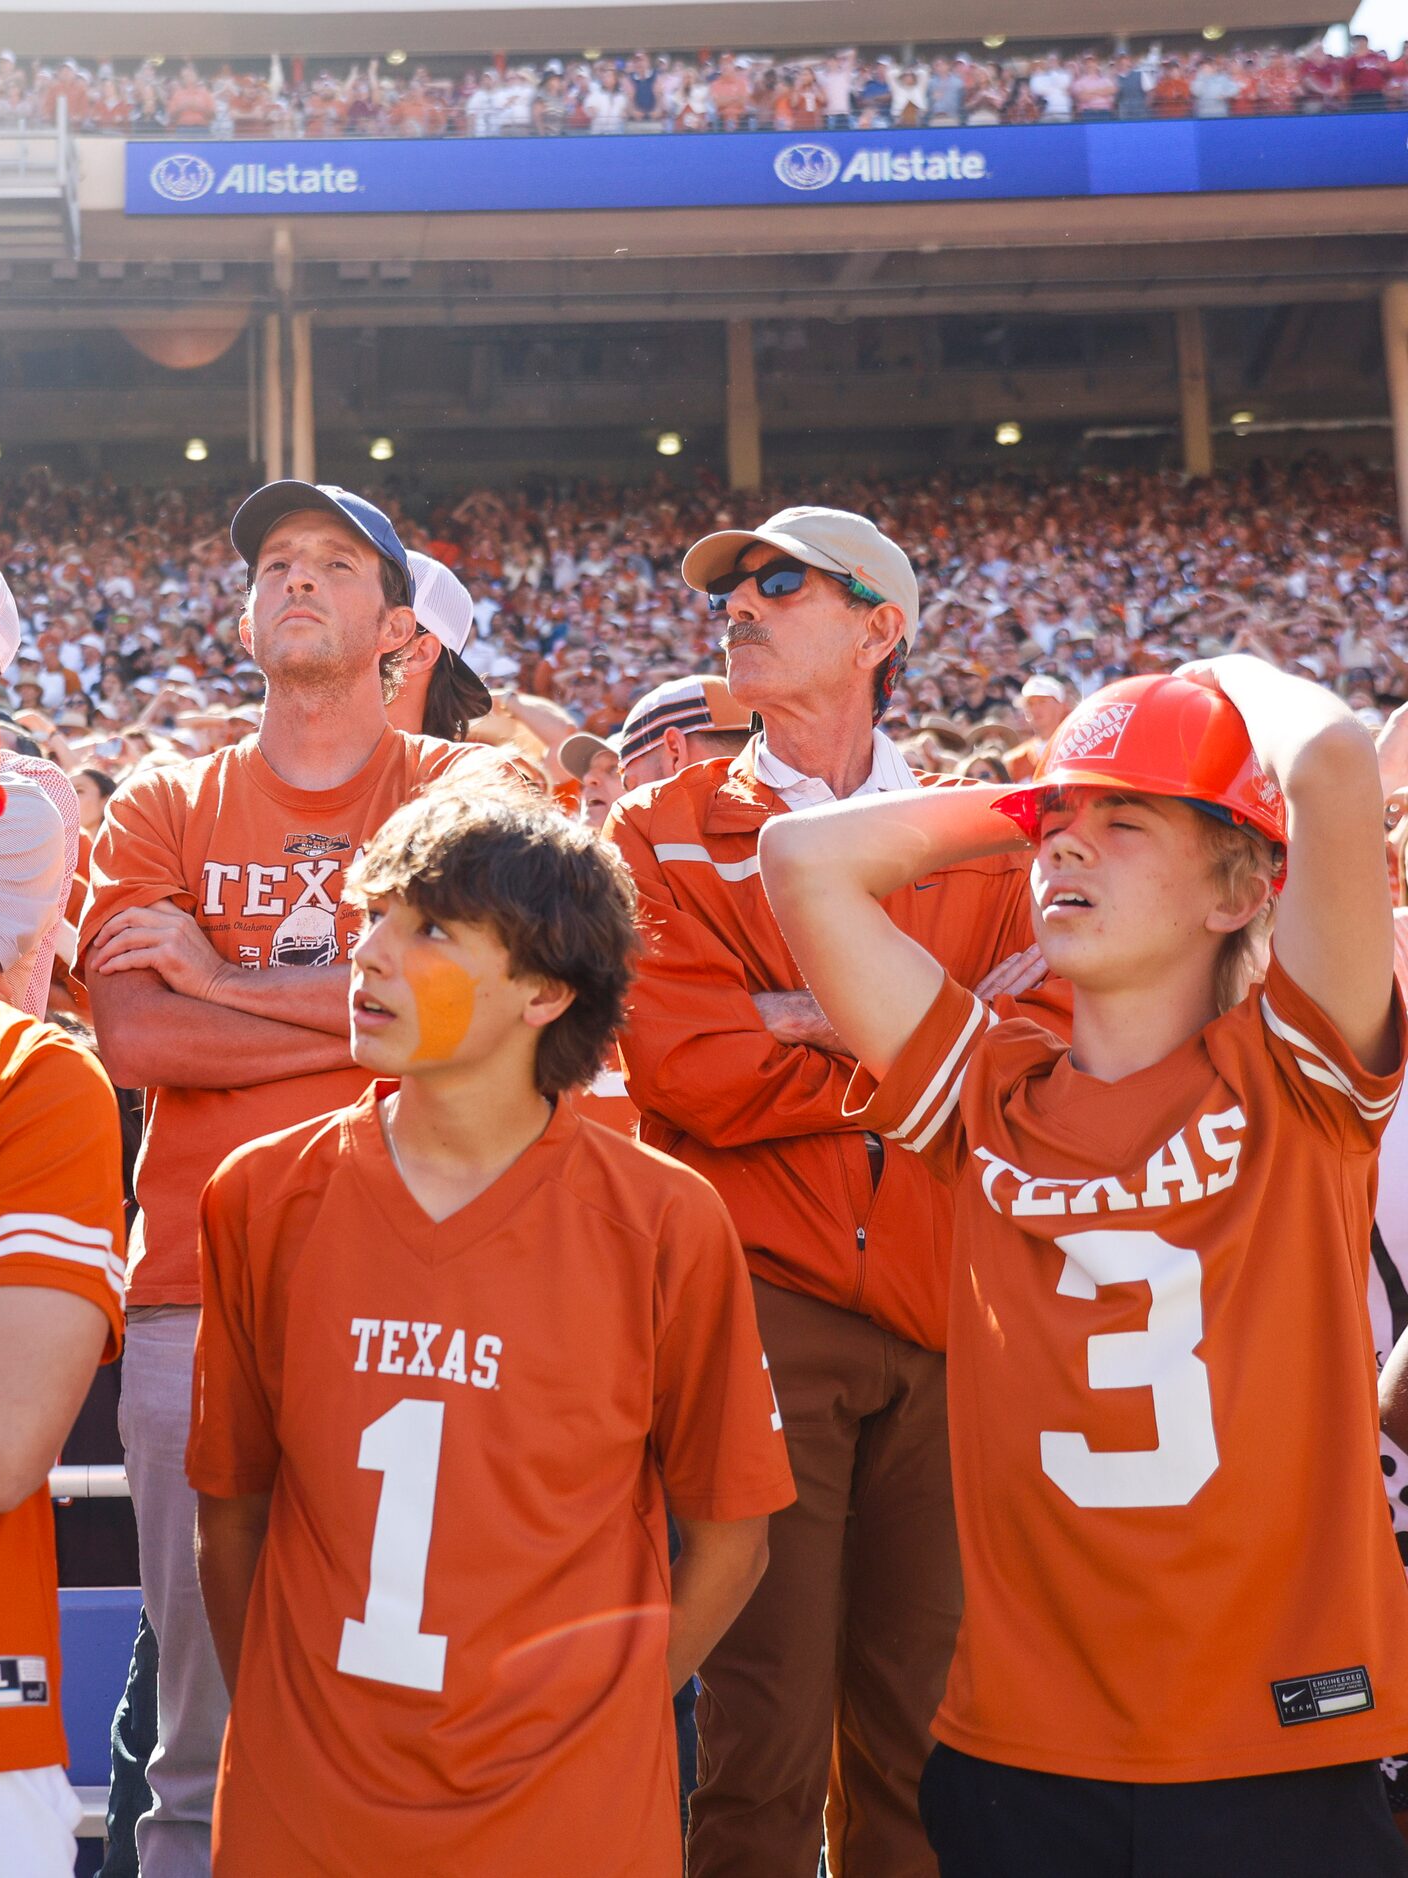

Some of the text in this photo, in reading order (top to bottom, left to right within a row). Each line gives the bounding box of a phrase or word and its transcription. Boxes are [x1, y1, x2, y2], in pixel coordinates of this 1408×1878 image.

[216, 164, 358, 194] Allstate
[841, 147, 986, 182] Allstate
[1058, 704, 1130, 759] HOME
[1076, 722, 1123, 757] DEPOT
[202, 848, 365, 916] TEX
[350, 1317, 503, 1390] TEXAS
[1039, 1229, 1220, 1508] 3
[337, 1398, 448, 1692] 1
[1312, 1674, 1362, 1688] ENGINEERED
[1284, 1703, 1312, 1713] TEAM
